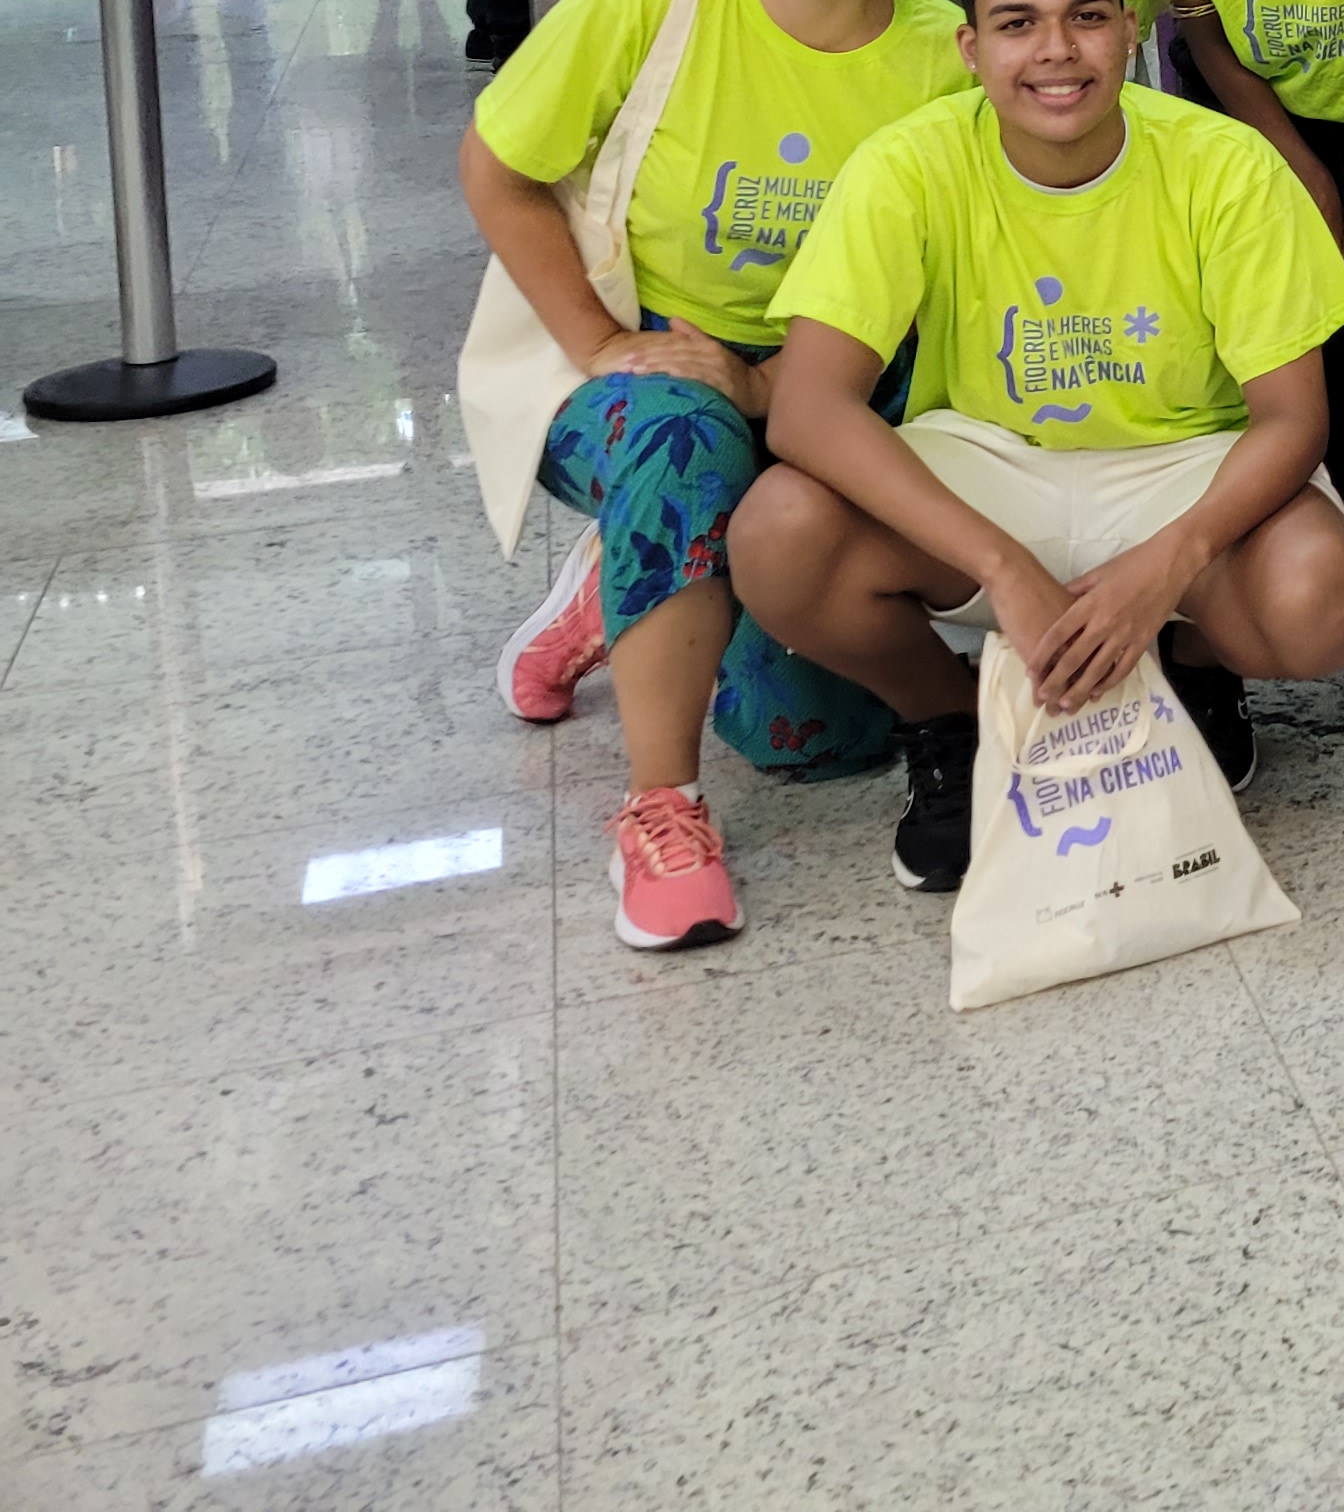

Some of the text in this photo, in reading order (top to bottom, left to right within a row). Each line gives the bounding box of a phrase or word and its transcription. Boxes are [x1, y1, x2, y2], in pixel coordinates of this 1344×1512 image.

[1261, 5, 1287, 58] FIOCRUZ
[1284, 23, 1294, 38] E
[1288, 41, 1314, 57] NA
[761, 200, 772, 220] E
[756, 227, 786, 248] NA
[1023, 319, 1047, 393] FIOCRUZ
[1050, 341, 1060, 361] E
[1052, 367, 1081, 391] NA
[1064, 746, 1183, 808] NA CIÊNCIA
[1172, 849, 1221, 879] BRASIL
